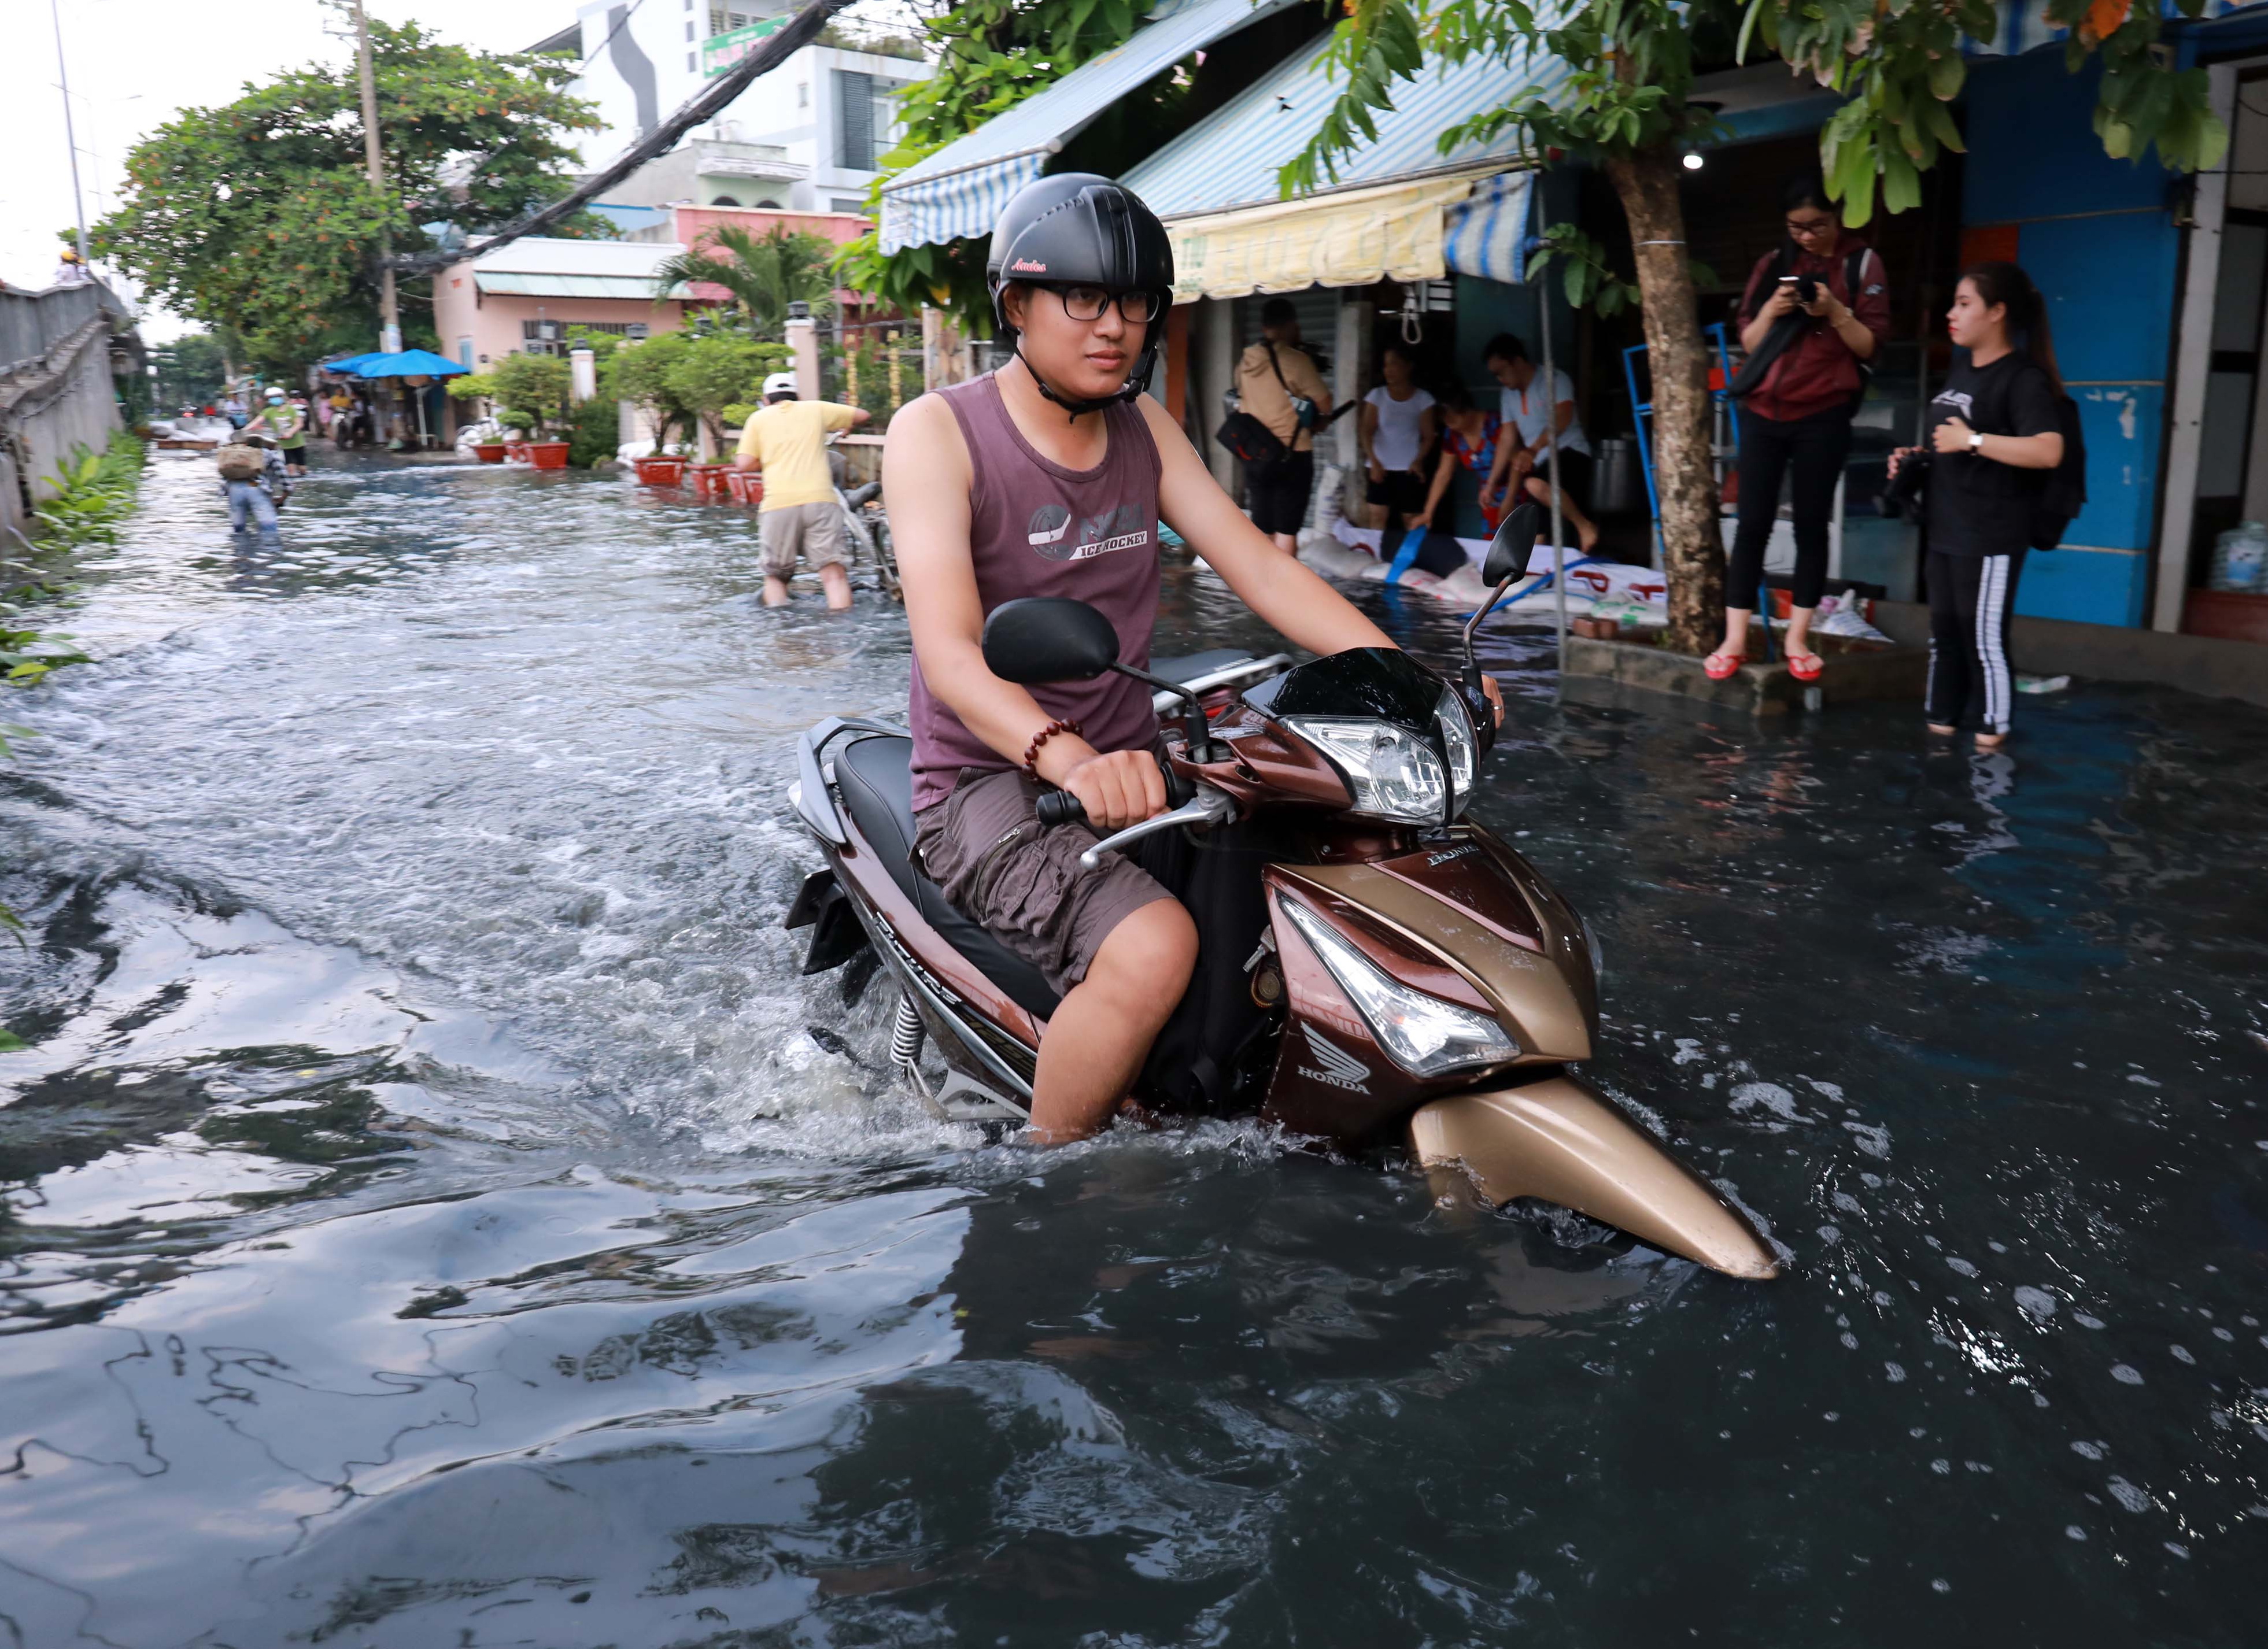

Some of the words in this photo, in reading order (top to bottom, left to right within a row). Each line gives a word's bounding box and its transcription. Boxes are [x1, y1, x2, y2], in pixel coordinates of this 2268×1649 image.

[1081, 545, 1102, 557] ICE
[1103, 533, 1145, 550] HOCKEY
[1298, 1064, 1372, 1095] HONDA
